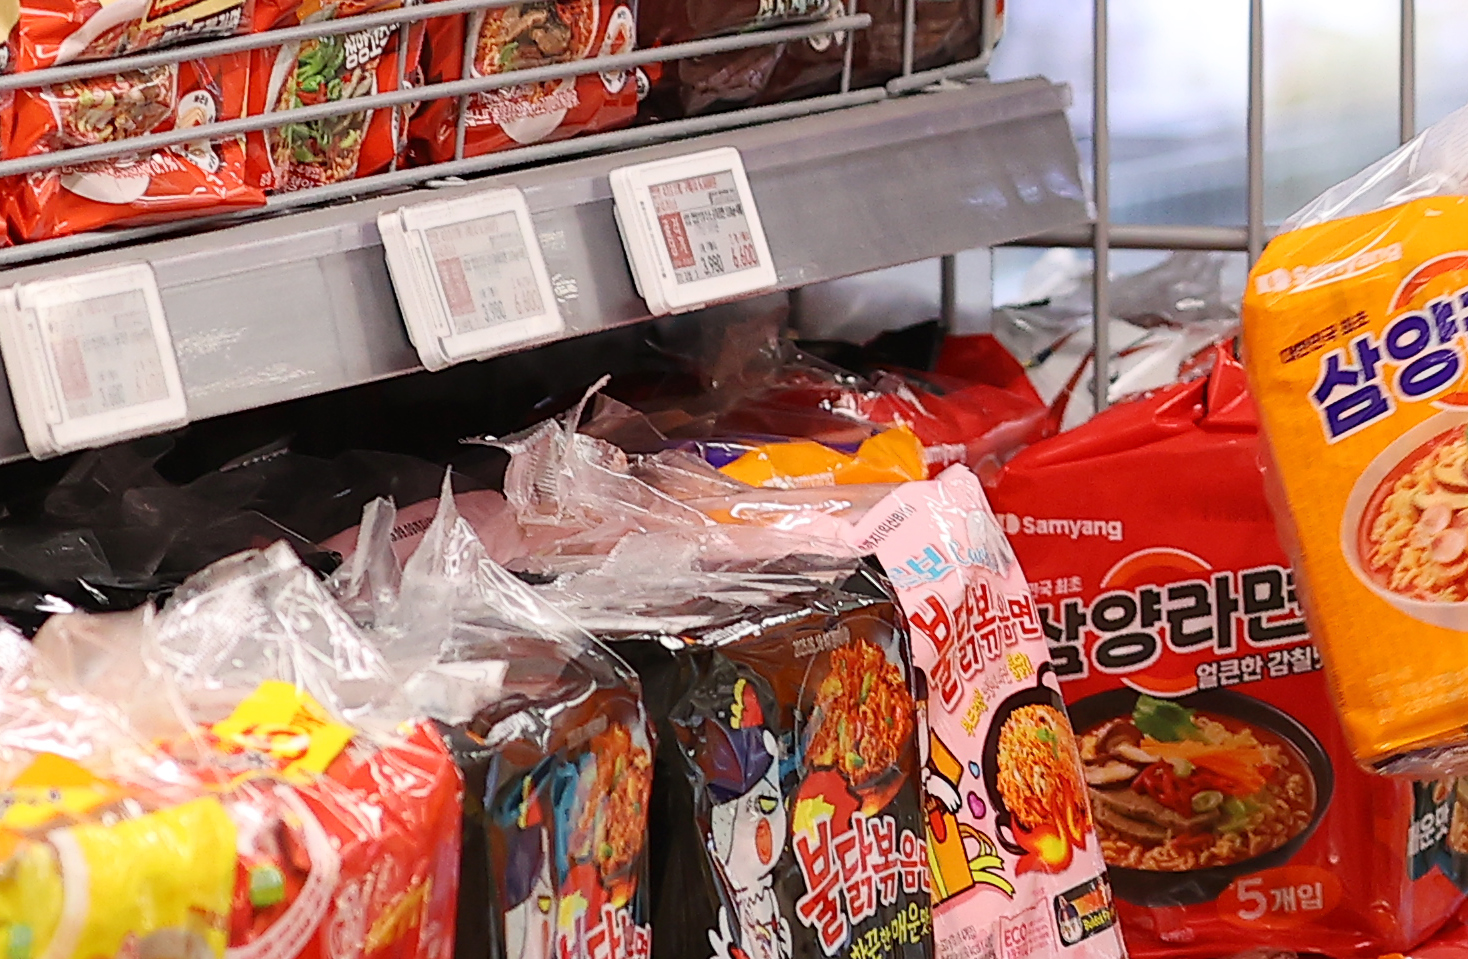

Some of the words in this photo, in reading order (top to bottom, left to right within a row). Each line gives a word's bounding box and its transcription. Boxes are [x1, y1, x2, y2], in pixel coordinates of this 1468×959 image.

[1021, 516, 1124, 541] Samyang
[1196, 654, 1265, 692] 얼큰한
[1235, 877, 1324, 921] 5개입
